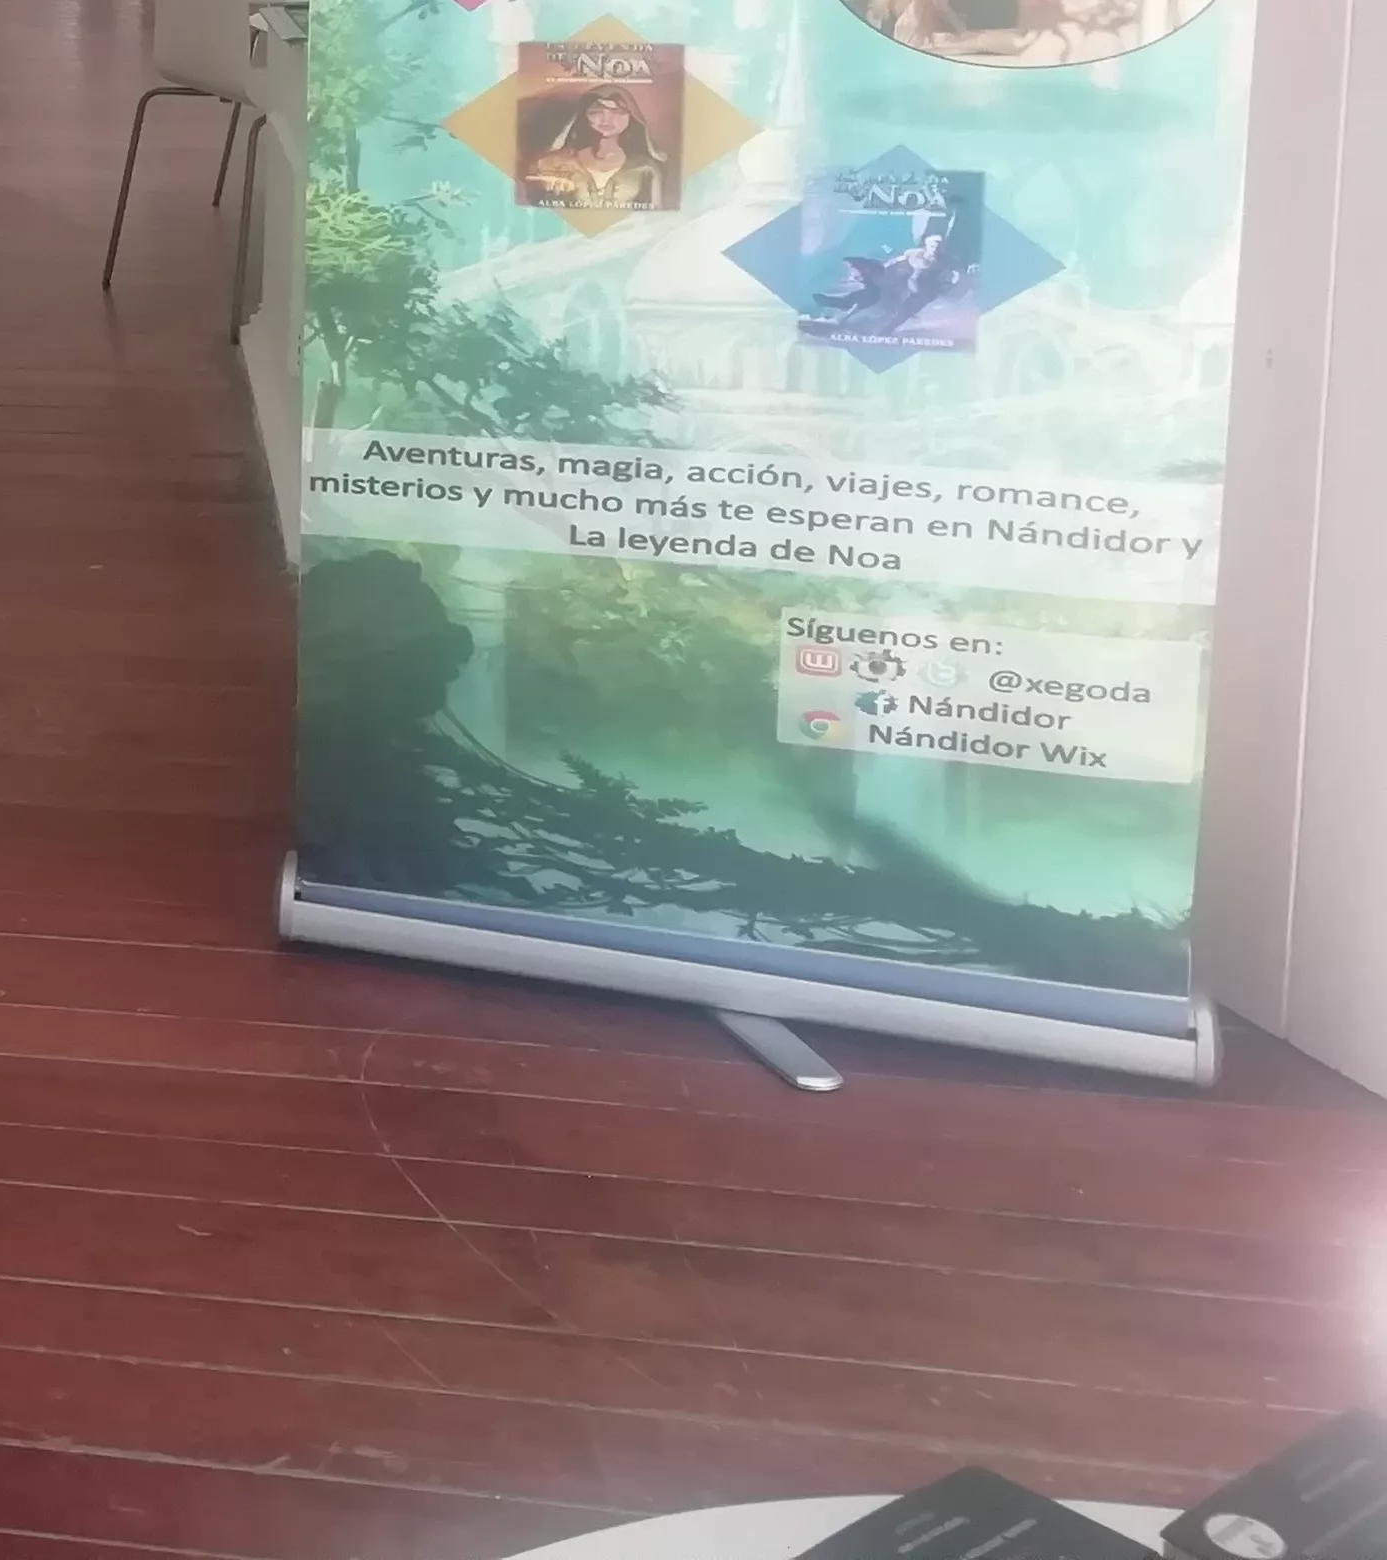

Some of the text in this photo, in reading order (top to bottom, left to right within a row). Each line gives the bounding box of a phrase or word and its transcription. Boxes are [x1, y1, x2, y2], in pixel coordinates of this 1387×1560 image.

[363, 439, 1140, 519] Aventuras, magia, acción, viajes, romance,
[309, 473, 1203, 561] misterios y mucho más te esperan en Nándidor y
[569, 524, 902, 571] La leyenda de Noa
[787, 616, 1003, 656] Síguenos en:
[988, 669, 1151, 704] @xegoda
[908, 695, 1071, 730] Nándidor
[869, 723, 1108, 769] Nándidor Wix
